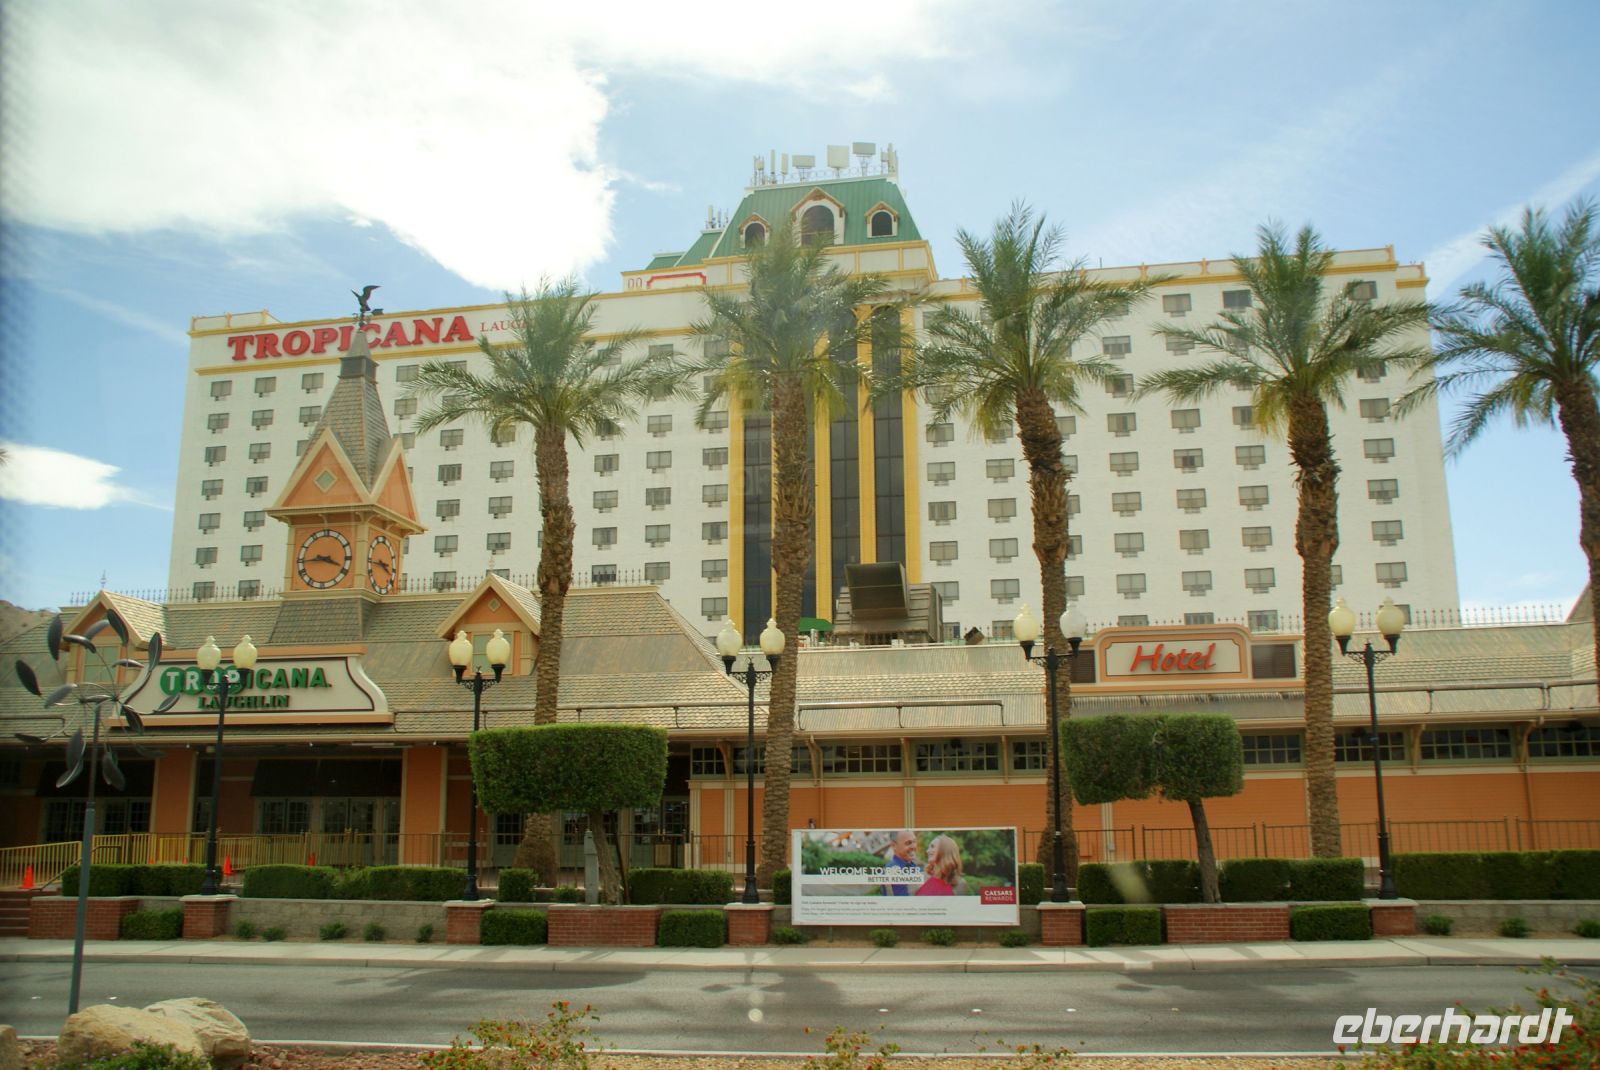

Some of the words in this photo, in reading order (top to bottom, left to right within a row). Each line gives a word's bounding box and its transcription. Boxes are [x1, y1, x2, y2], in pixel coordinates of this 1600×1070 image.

[228, 316, 474, 361] TROPICANA
[1129, 642, 1217, 672] Hotel
[819, 866, 868, 876] WELCOME
[870, 866, 883, 876] TO
